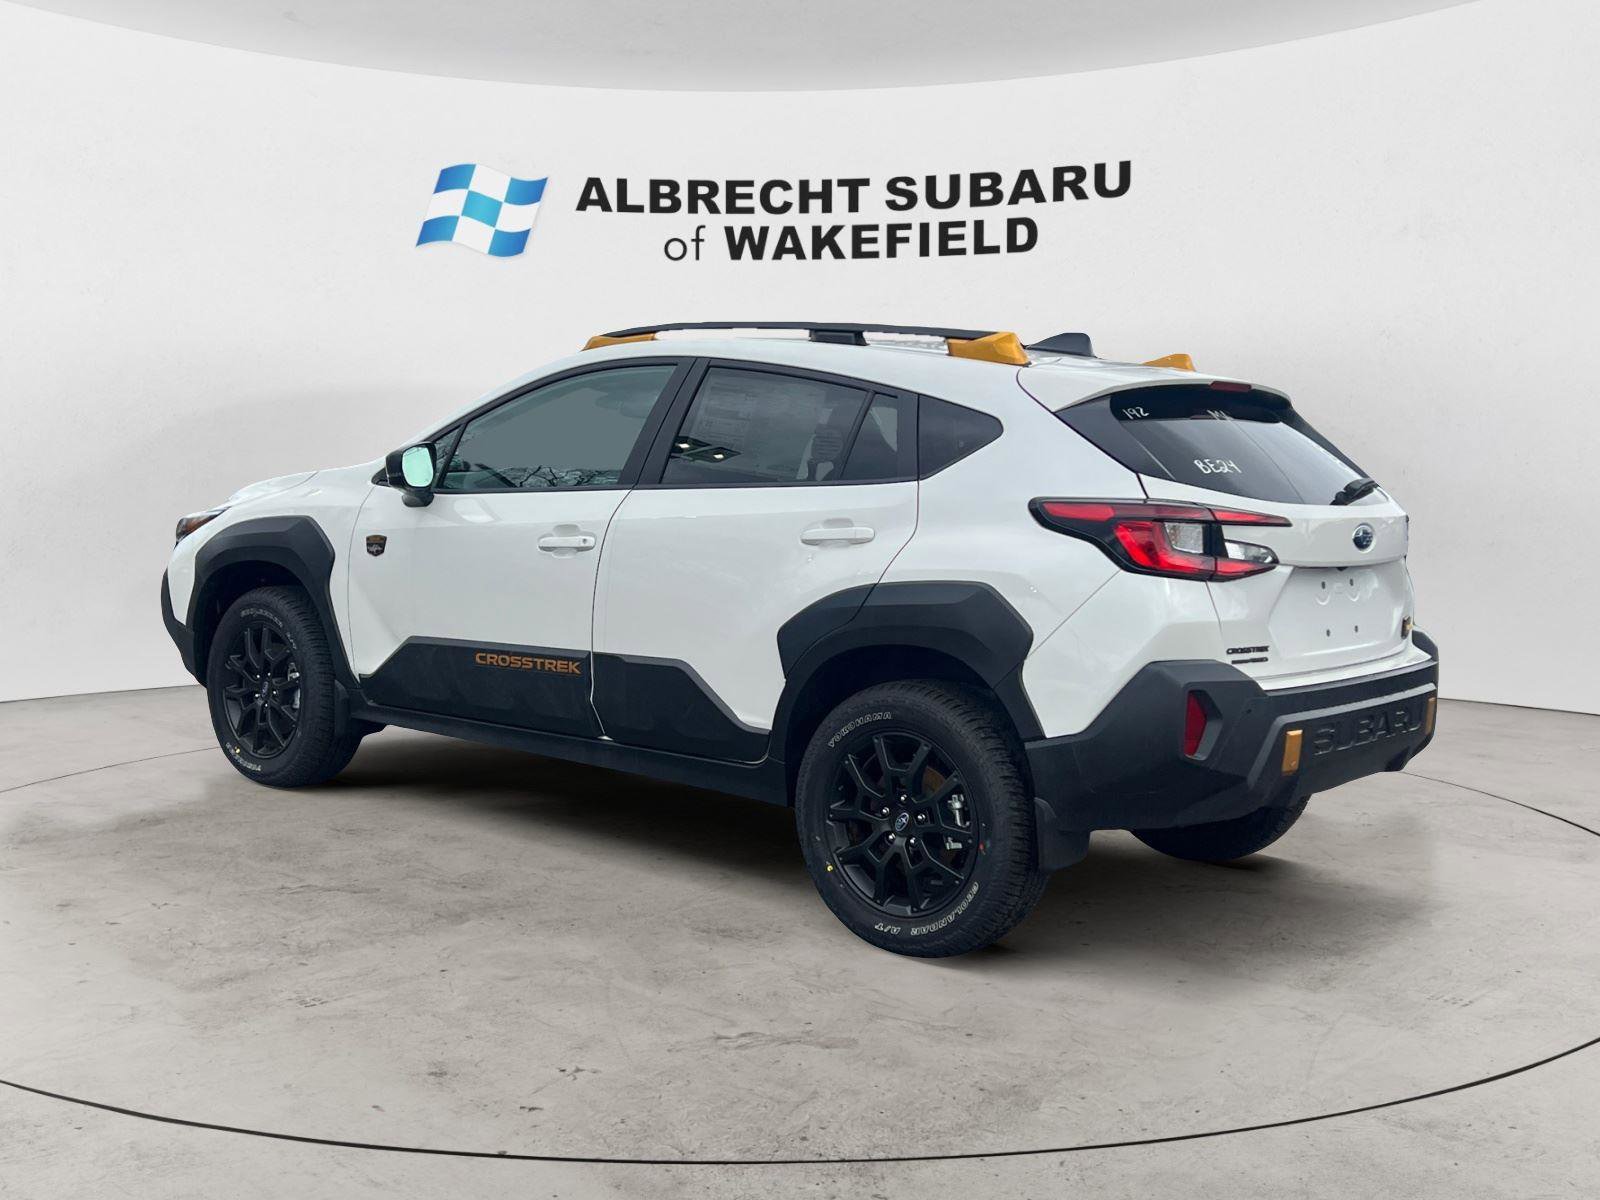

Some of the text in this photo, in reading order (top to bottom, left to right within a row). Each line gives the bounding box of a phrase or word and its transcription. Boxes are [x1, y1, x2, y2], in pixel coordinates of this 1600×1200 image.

[575, 160, 1131, 215] ALBRECHT SUBARU
[663, 216, 1039, 262] of WAKEFIELD
[474, 652, 582, 675] CROSSTREK
[827, 711, 892, 748] YOKOHAMA
[1312, 706, 1424, 757] SUBARU
[873, 881, 980, 936] GEOLANDAR A/T
